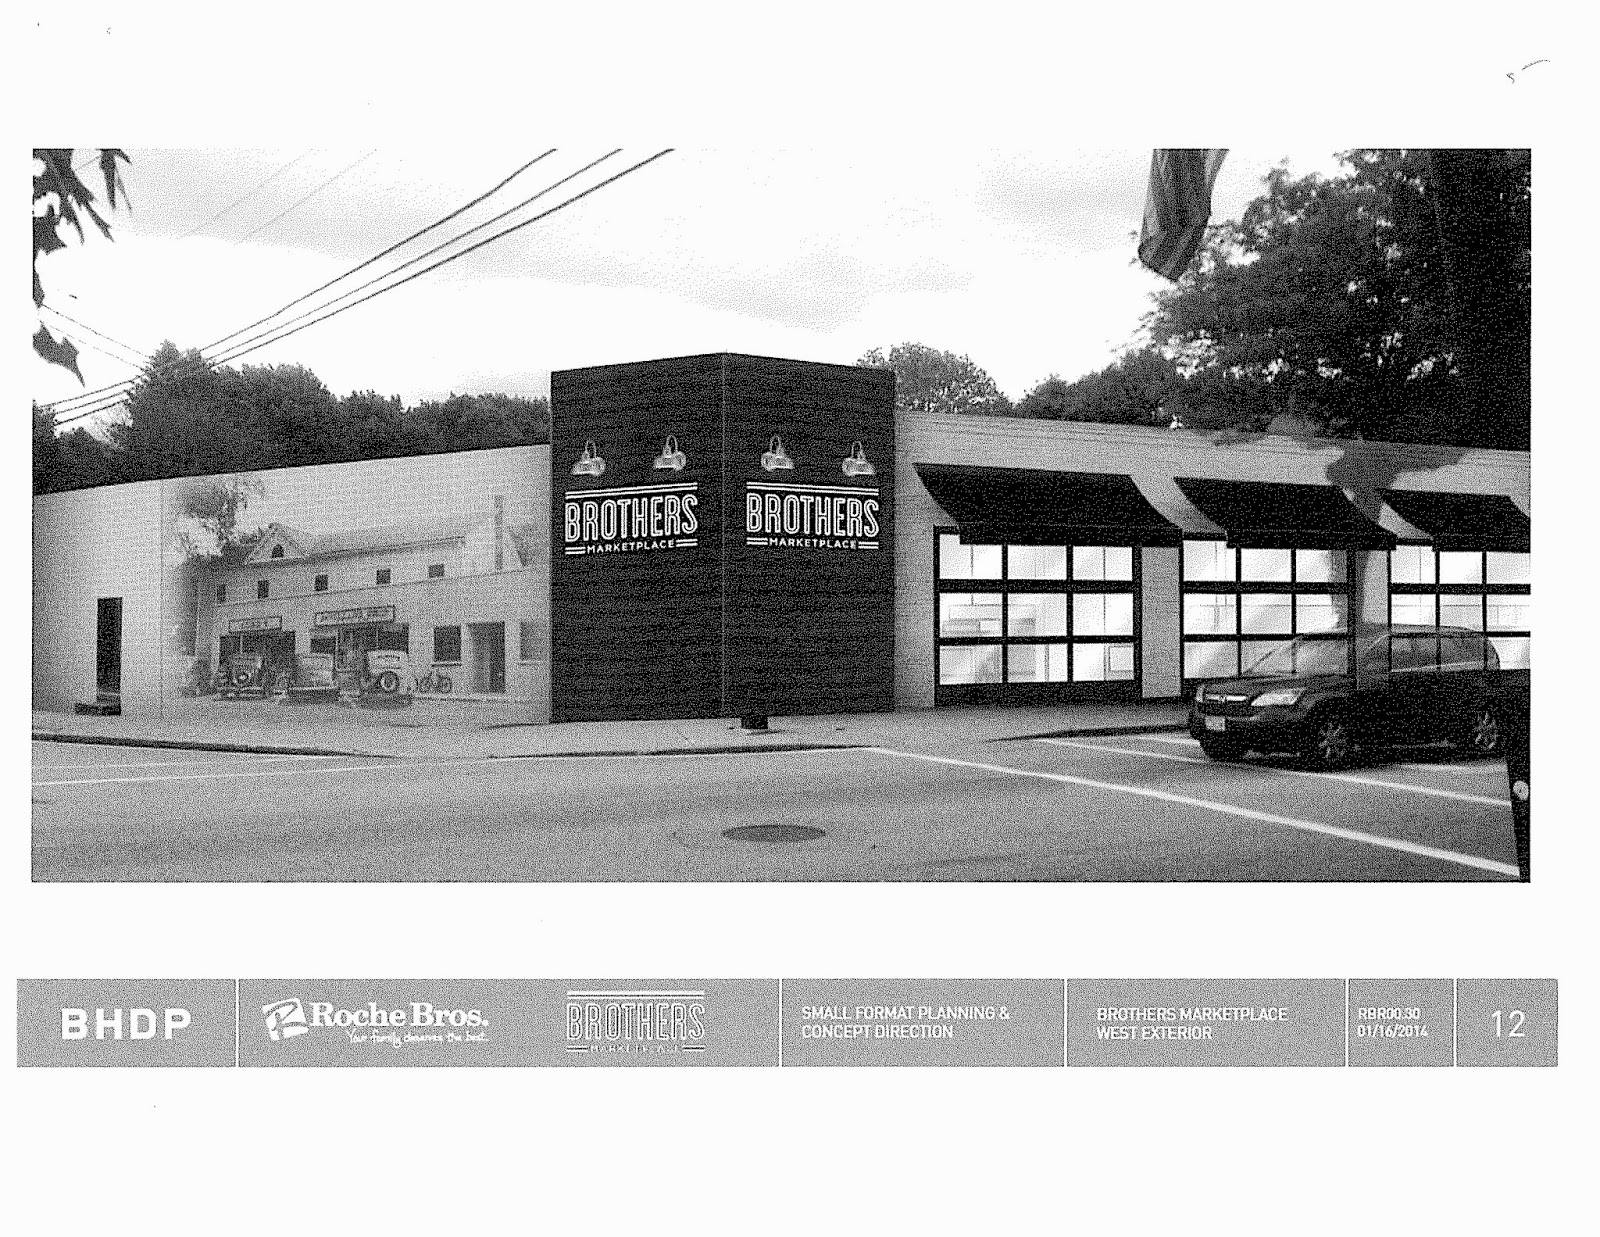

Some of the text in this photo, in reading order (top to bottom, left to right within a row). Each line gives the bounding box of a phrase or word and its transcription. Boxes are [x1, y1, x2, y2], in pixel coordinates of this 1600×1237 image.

[565, 494, 697, 542] BROTHERS
[746, 492, 879, 537] BROTHERS
[586, 540, 675, 554] MARKETPLACE
[769, 537, 858, 549] MARKETPLACE
[309, 1002, 489, 1027] Roche Bros.
[801, 1006, 1011, 1020] SMALL FORMAT PLANNING &
[1097, 1007, 1288, 1021] BROTHERS MARKETPLACE
[61, 1008, 192, 1041] BHDP
[566, 1002, 706, 1041] BROTHERS
[1491, 1010, 1526, 1038] 12
[801, 1024, 954, 1039] CONCEPT DIRECTION
[1097, 1026, 1213, 1040] WEST EXTERIOR
[1357, 1024, 1429, 1038] 01/16/2014
[589, 1043, 682, 1053] MARKTPA
